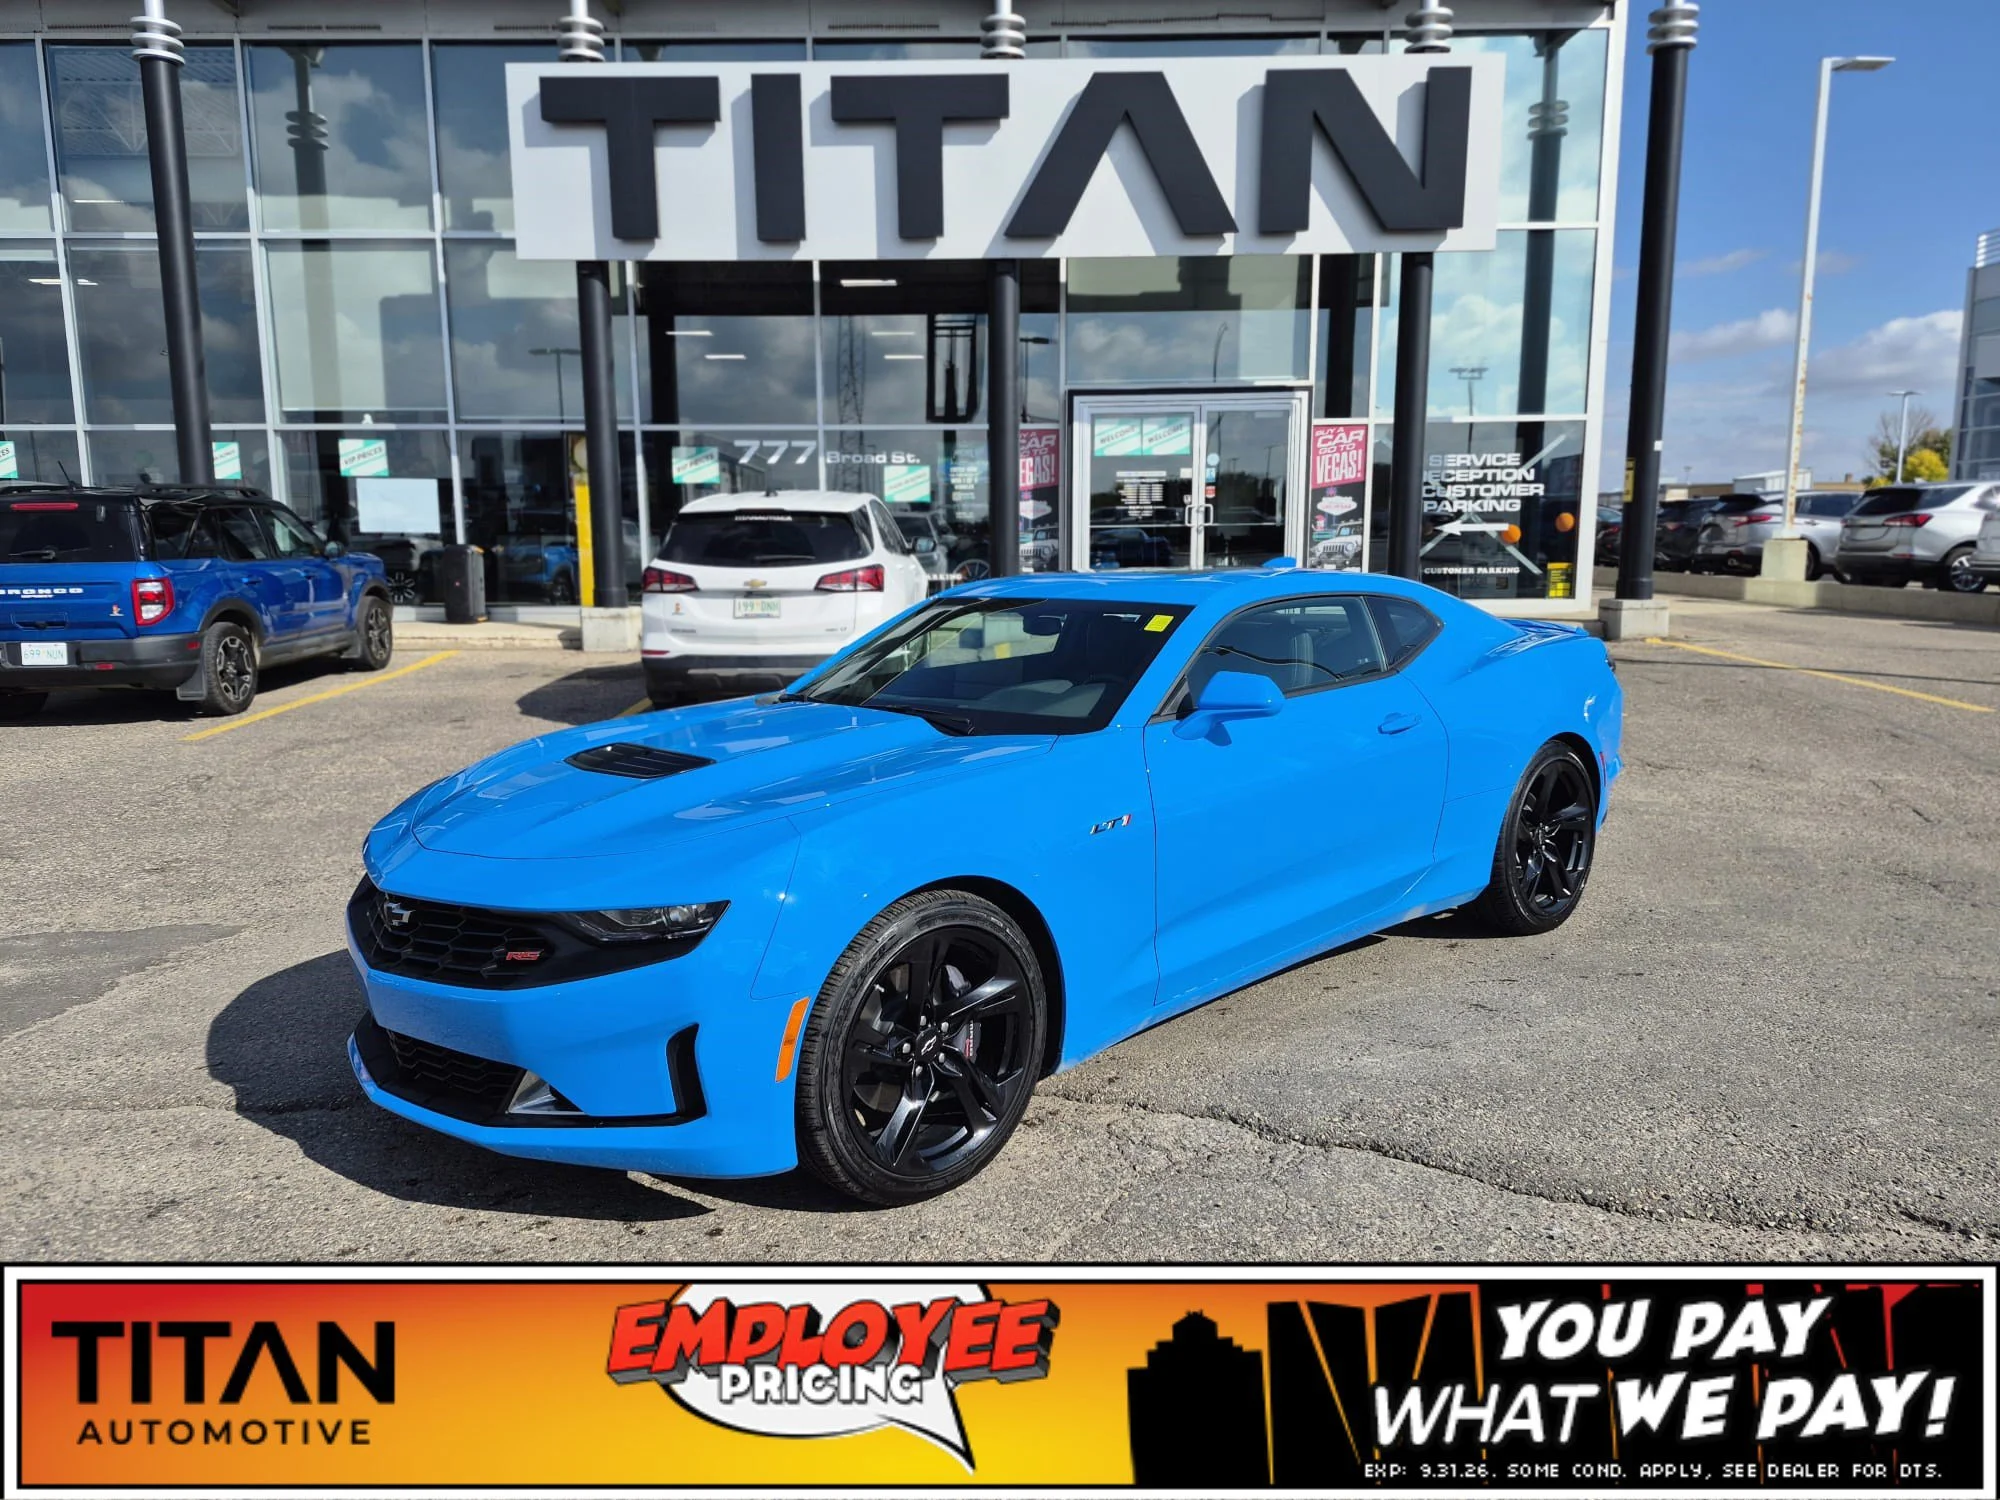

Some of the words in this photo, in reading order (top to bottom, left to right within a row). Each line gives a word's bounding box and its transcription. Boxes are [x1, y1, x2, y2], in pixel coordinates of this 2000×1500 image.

[540, 67, 1472, 241] TITAN
[1317, 430, 1366, 449] CAR
[1339, 443, 1356, 451] TO
[733, 439, 817, 464] 777
[826, 451, 887, 464] Broad
[891, 451, 921, 464] St.
[1317, 449, 1363, 484] VEGAS!
[1429, 453, 1521, 466] SERVICE
[1019, 454, 1055, 486] EGAS!
[1422, 483, 1545, 498] CUSTOMER
[1423, 499, 1521, 513] PARKING
[1476, 566, 1520, 574] PARKING
[1090, 814, 1131, 835] LT1
[506, 951, 541, 960] RS
